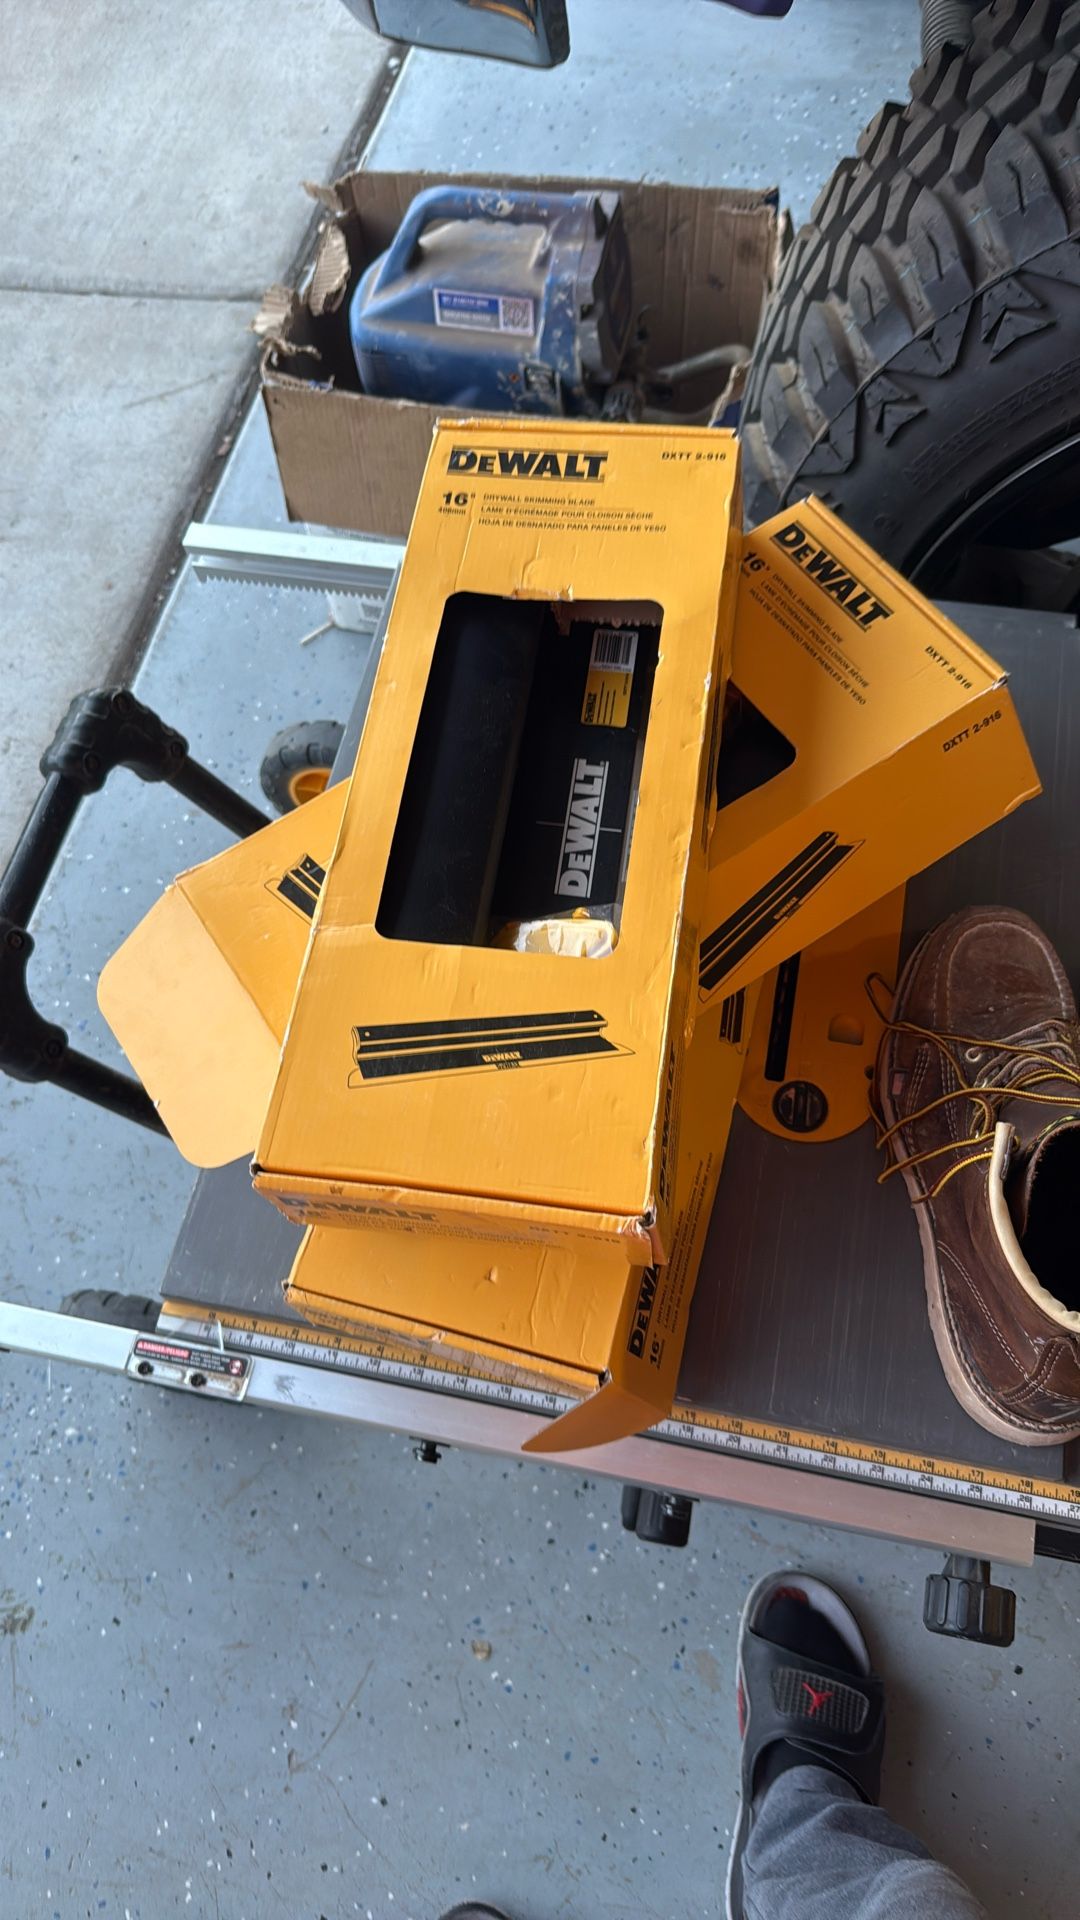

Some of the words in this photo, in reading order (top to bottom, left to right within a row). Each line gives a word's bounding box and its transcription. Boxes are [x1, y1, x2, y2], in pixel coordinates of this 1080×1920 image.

[447, 448, 608, 480] DEWALT
[661, 451, 692, 461] DXTT
[481, 506, 504, 515] LAME
[561, 510, 584, 519] POUR
[483, 493, 522, 503] DRYWALL
[524, 495, 565, 506] SKIMMING
[568, 497, 596, 507] BLADE
[478, 517, 500, 527] HOJA
[502, 519, 513, 528] DE
[566, 522, 589, 531] PARA
[590, 523, 628, 533] PANELES
[630, 524, 642, 533] DE
[644, 524, 667, 534] YESO
[773, 521, 891, 630] DEWALT
[924, 645, 949, 668] DXTT
[849, 689, 867, 706] YESO
[942, 728, 971, 753] DXTT
[972, 709, 1002, 735] 2-916
[558, 758, 605, 896] DEWALT
[280, 1196, 438, 1222] DEWALT
[729, 1435, 738, 1443] 20
[823, 1454, 833, 1463] 22
[871, 1464, 882, 1472] 23
[920, 1474, 930, 1482] 24
[970, 1484, 980, 1492] 25
[1020, 1494, 1030, 1503] 26
[778, 1430, 787, 1438] 13
[826, 1440, 835, 1448] 14
[874, 1450, 883, 1458] 15
[922, 1459, 931, 1467] 16
[1020, 1480, 1030, 1488] 18
